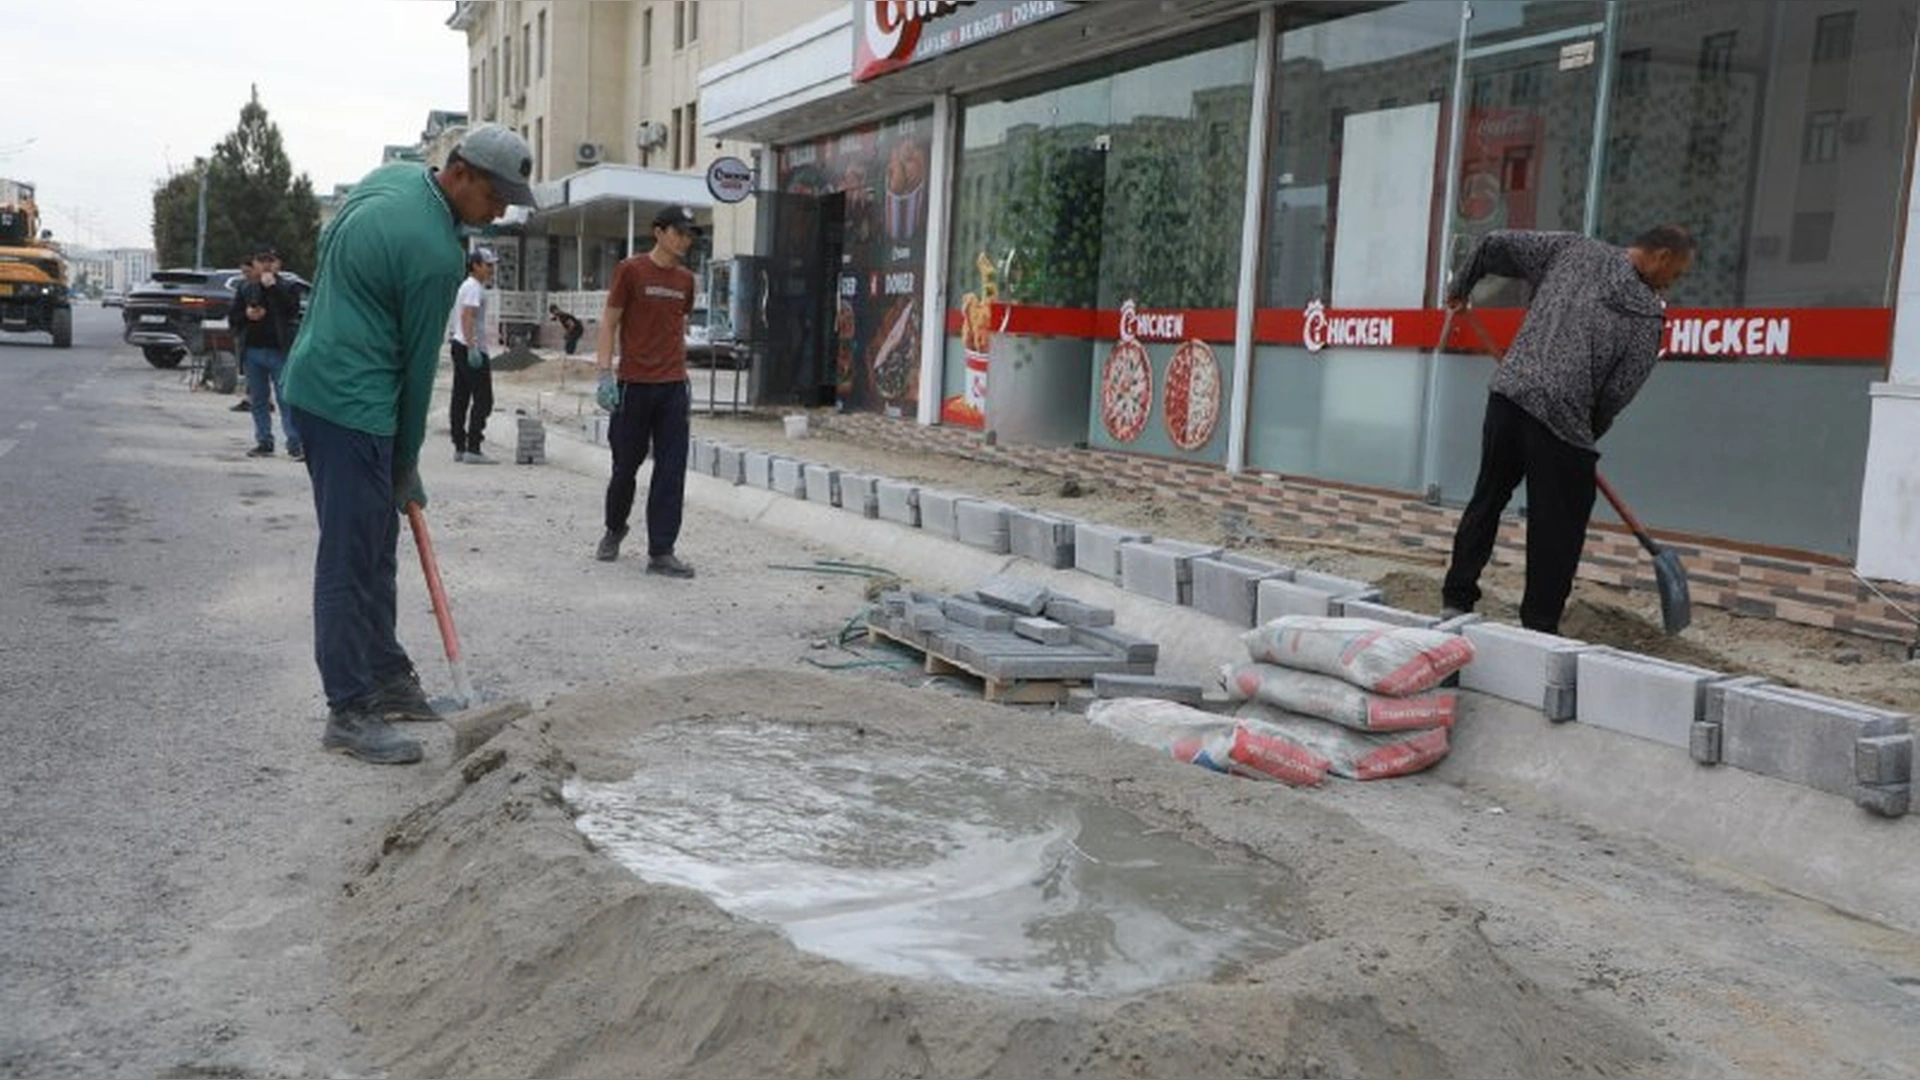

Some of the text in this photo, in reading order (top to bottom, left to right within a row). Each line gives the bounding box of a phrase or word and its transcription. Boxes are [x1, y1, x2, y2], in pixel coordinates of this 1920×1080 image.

[1120, 304, 1184, 341] CHICKEN
[1303, 306, 1393, 352] CHICKEN
[1659, 318, 1790, 357] HICKEN
